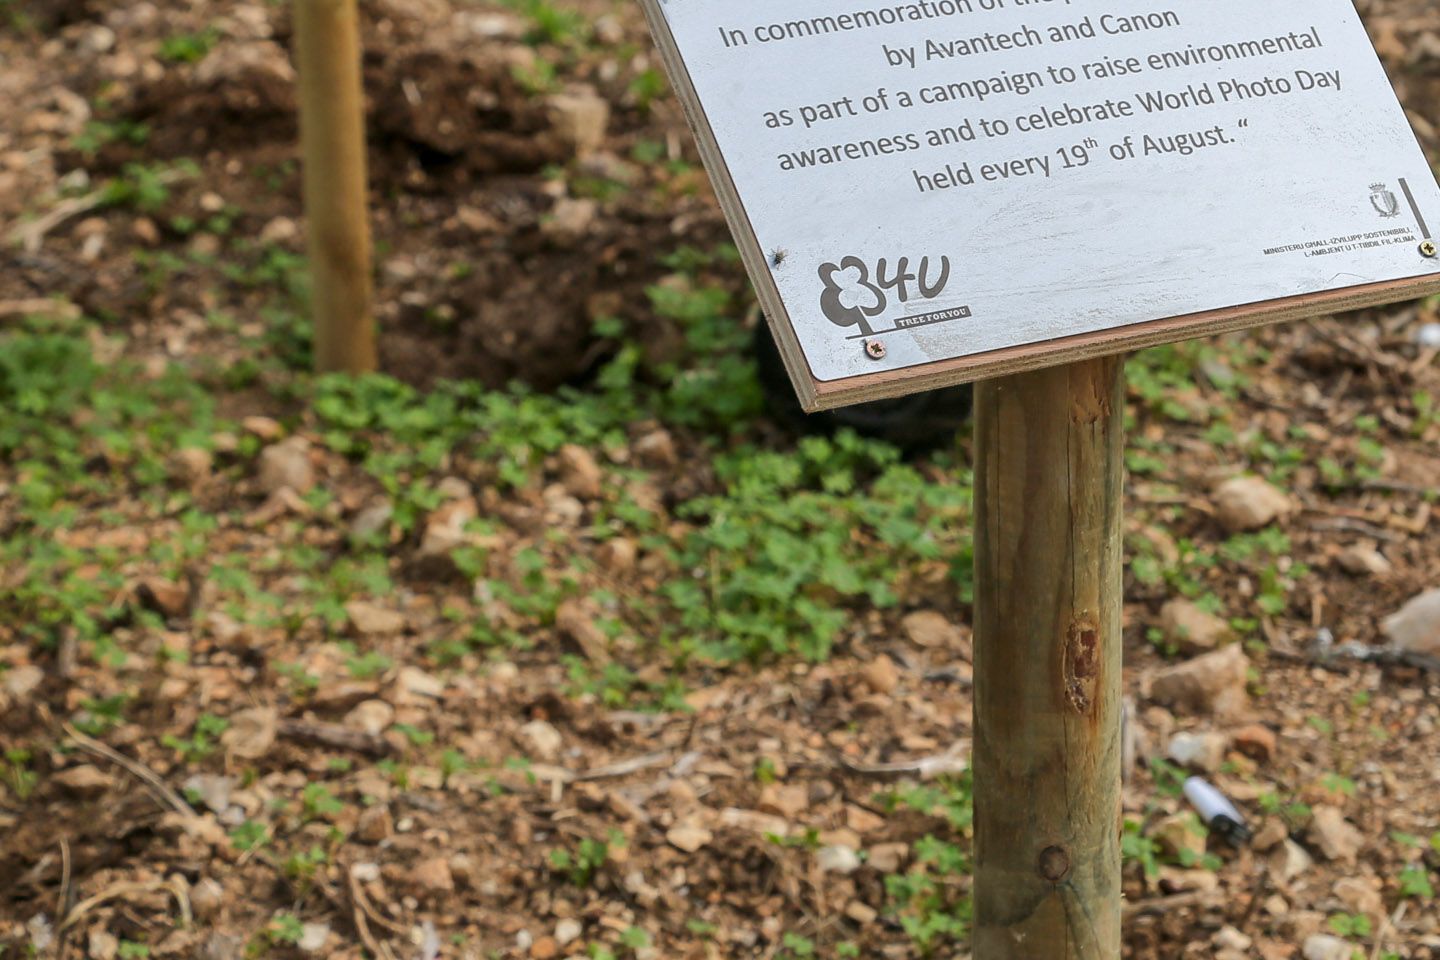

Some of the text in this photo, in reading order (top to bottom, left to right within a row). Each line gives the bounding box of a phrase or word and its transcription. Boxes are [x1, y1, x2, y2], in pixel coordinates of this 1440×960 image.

[718, 26, 749, 48] In
[881, 10, 1181, 69] by Avantech and Canon
[762, 25, 1323, 129] as part of a campaign to raise environmental
[776, 69, 1343, 171] awareness and to celebrate World Photo Day
[912, 161, 975, 193] held
[979, 155, 1050, 182] every
[1055, 136, 1099, 169] 19th
[1108, 135, 1136, 161] of
[898, 308, 967, 327] TREE FOR YOU
